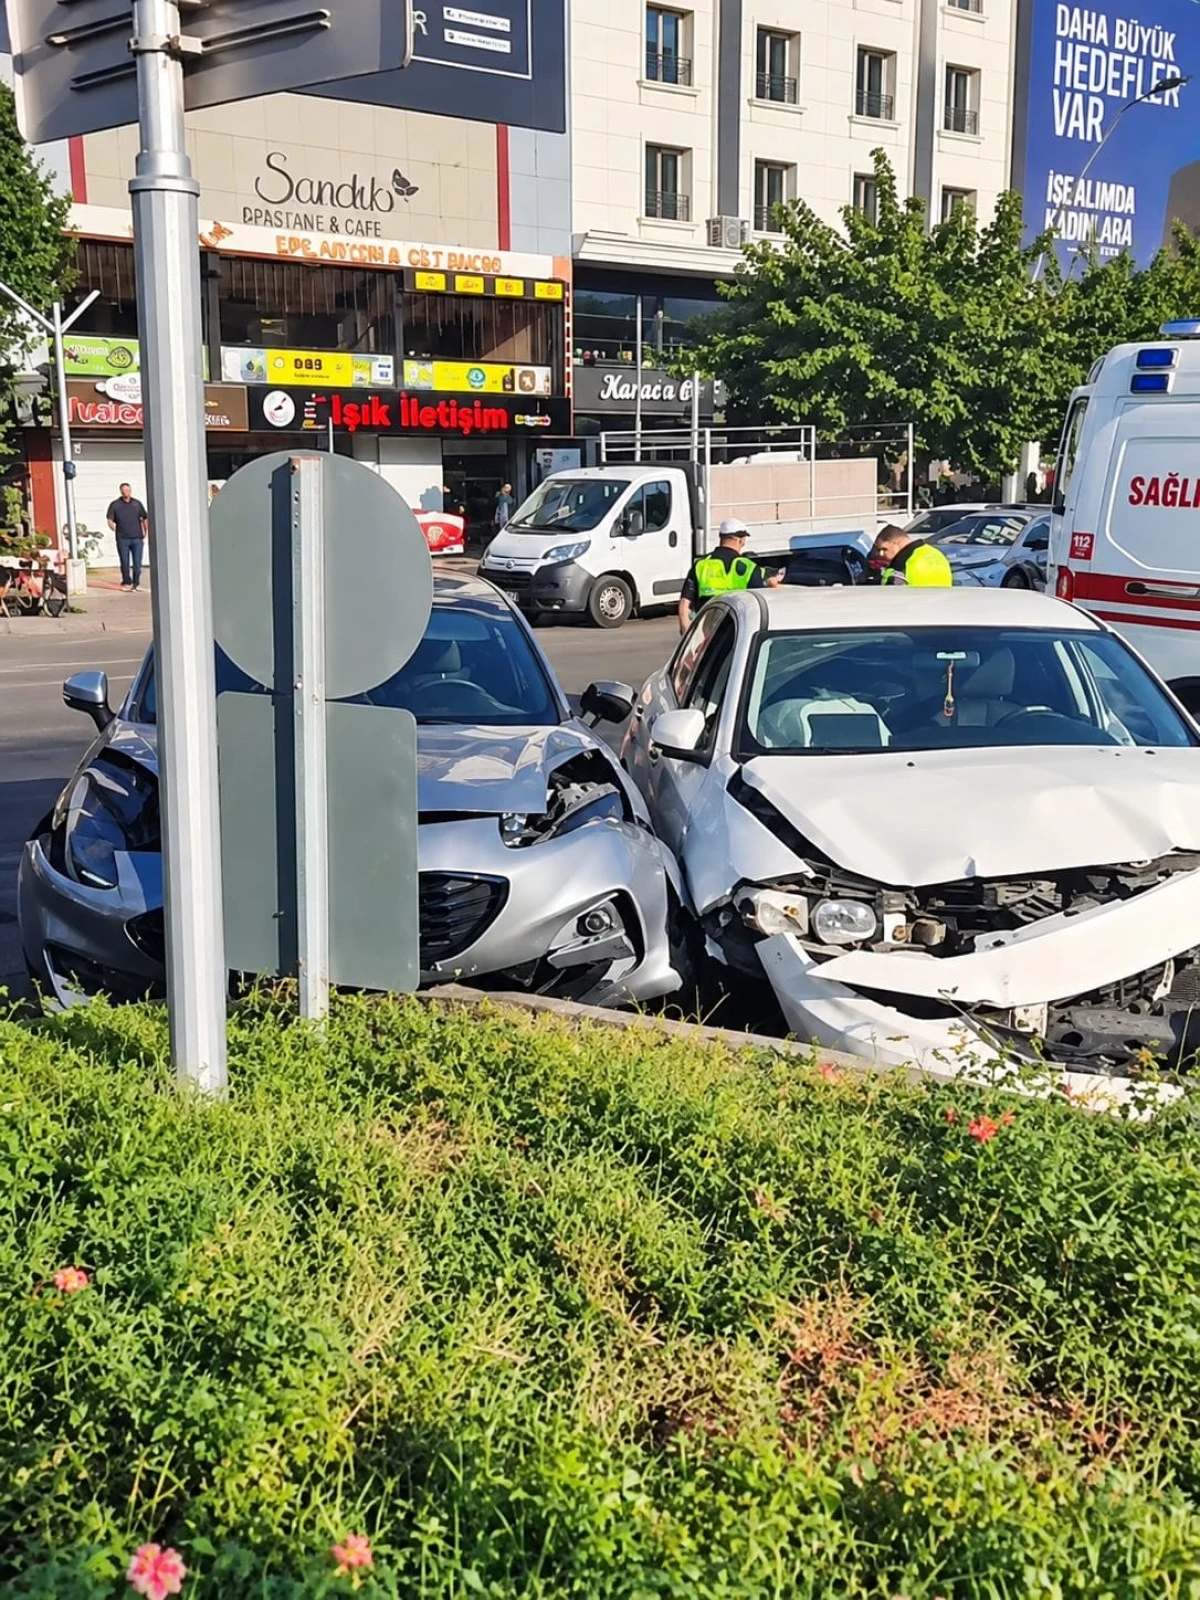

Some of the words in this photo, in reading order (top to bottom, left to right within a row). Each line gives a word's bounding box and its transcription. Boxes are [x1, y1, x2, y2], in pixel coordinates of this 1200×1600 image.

[1056, 3, 1109, 47] DAHA
[1114, 18, 1177, 62] BÜYÜK
[1053, 39, 1182, 108] HEDEFLER
[1052, 88, 1104, 143] VAR
[1046, 169, 1075, 208] İŞE
[1073, 177, 1136, 215] ALIMDA
[329, 215, 340, 234] &
[344, 218, 382, 238] CAFE
[1044, 208, 1133, 247] KADINLARA
[331, 393, 392, 432] Işık
[400, 391, 508, 435] İletişim
[1073, 535, 1091, 549] 112
